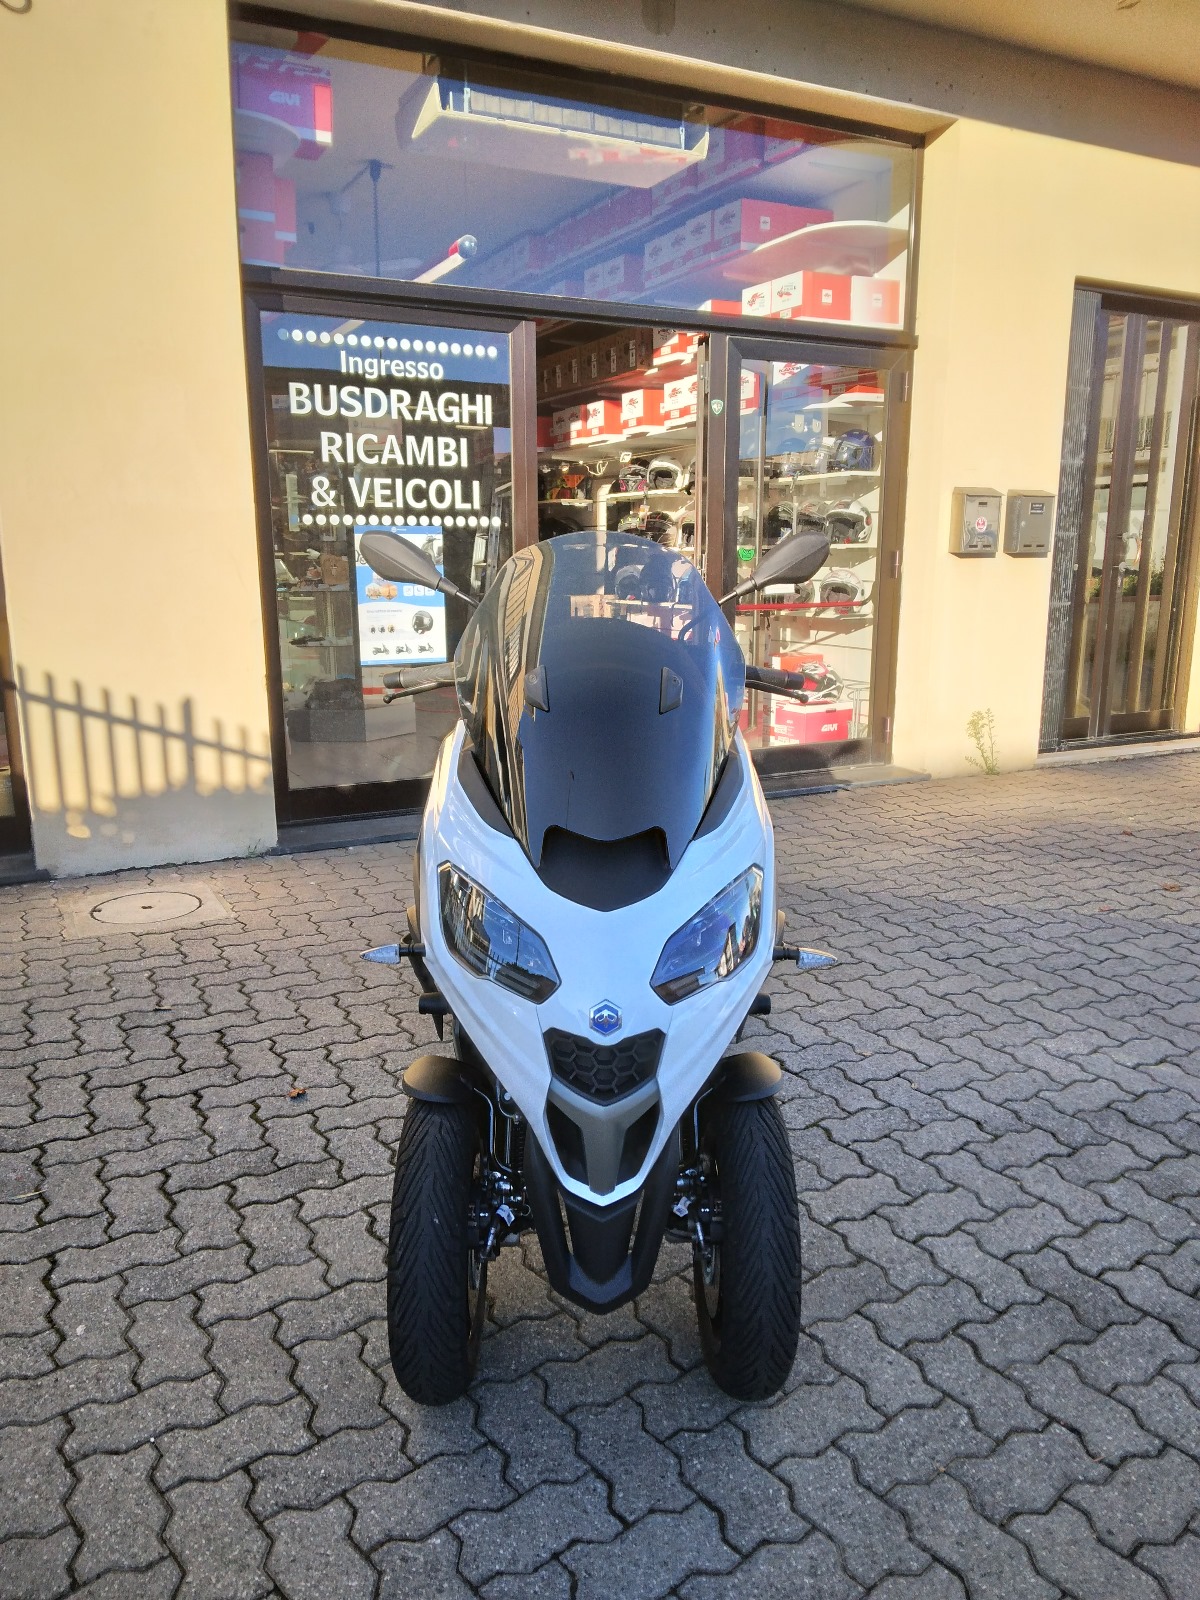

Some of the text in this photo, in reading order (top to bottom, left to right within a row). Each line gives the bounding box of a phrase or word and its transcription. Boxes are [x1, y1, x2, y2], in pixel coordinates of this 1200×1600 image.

[340, 350, 444, 379] Ingresso
[288, 382, 493, 425] BUSDRAGHI
[320, 431, 469, 467] RICAMBI
[311, 476, 481, 510] & VEICOLI
[821, 723, 838, 732] GIVI
